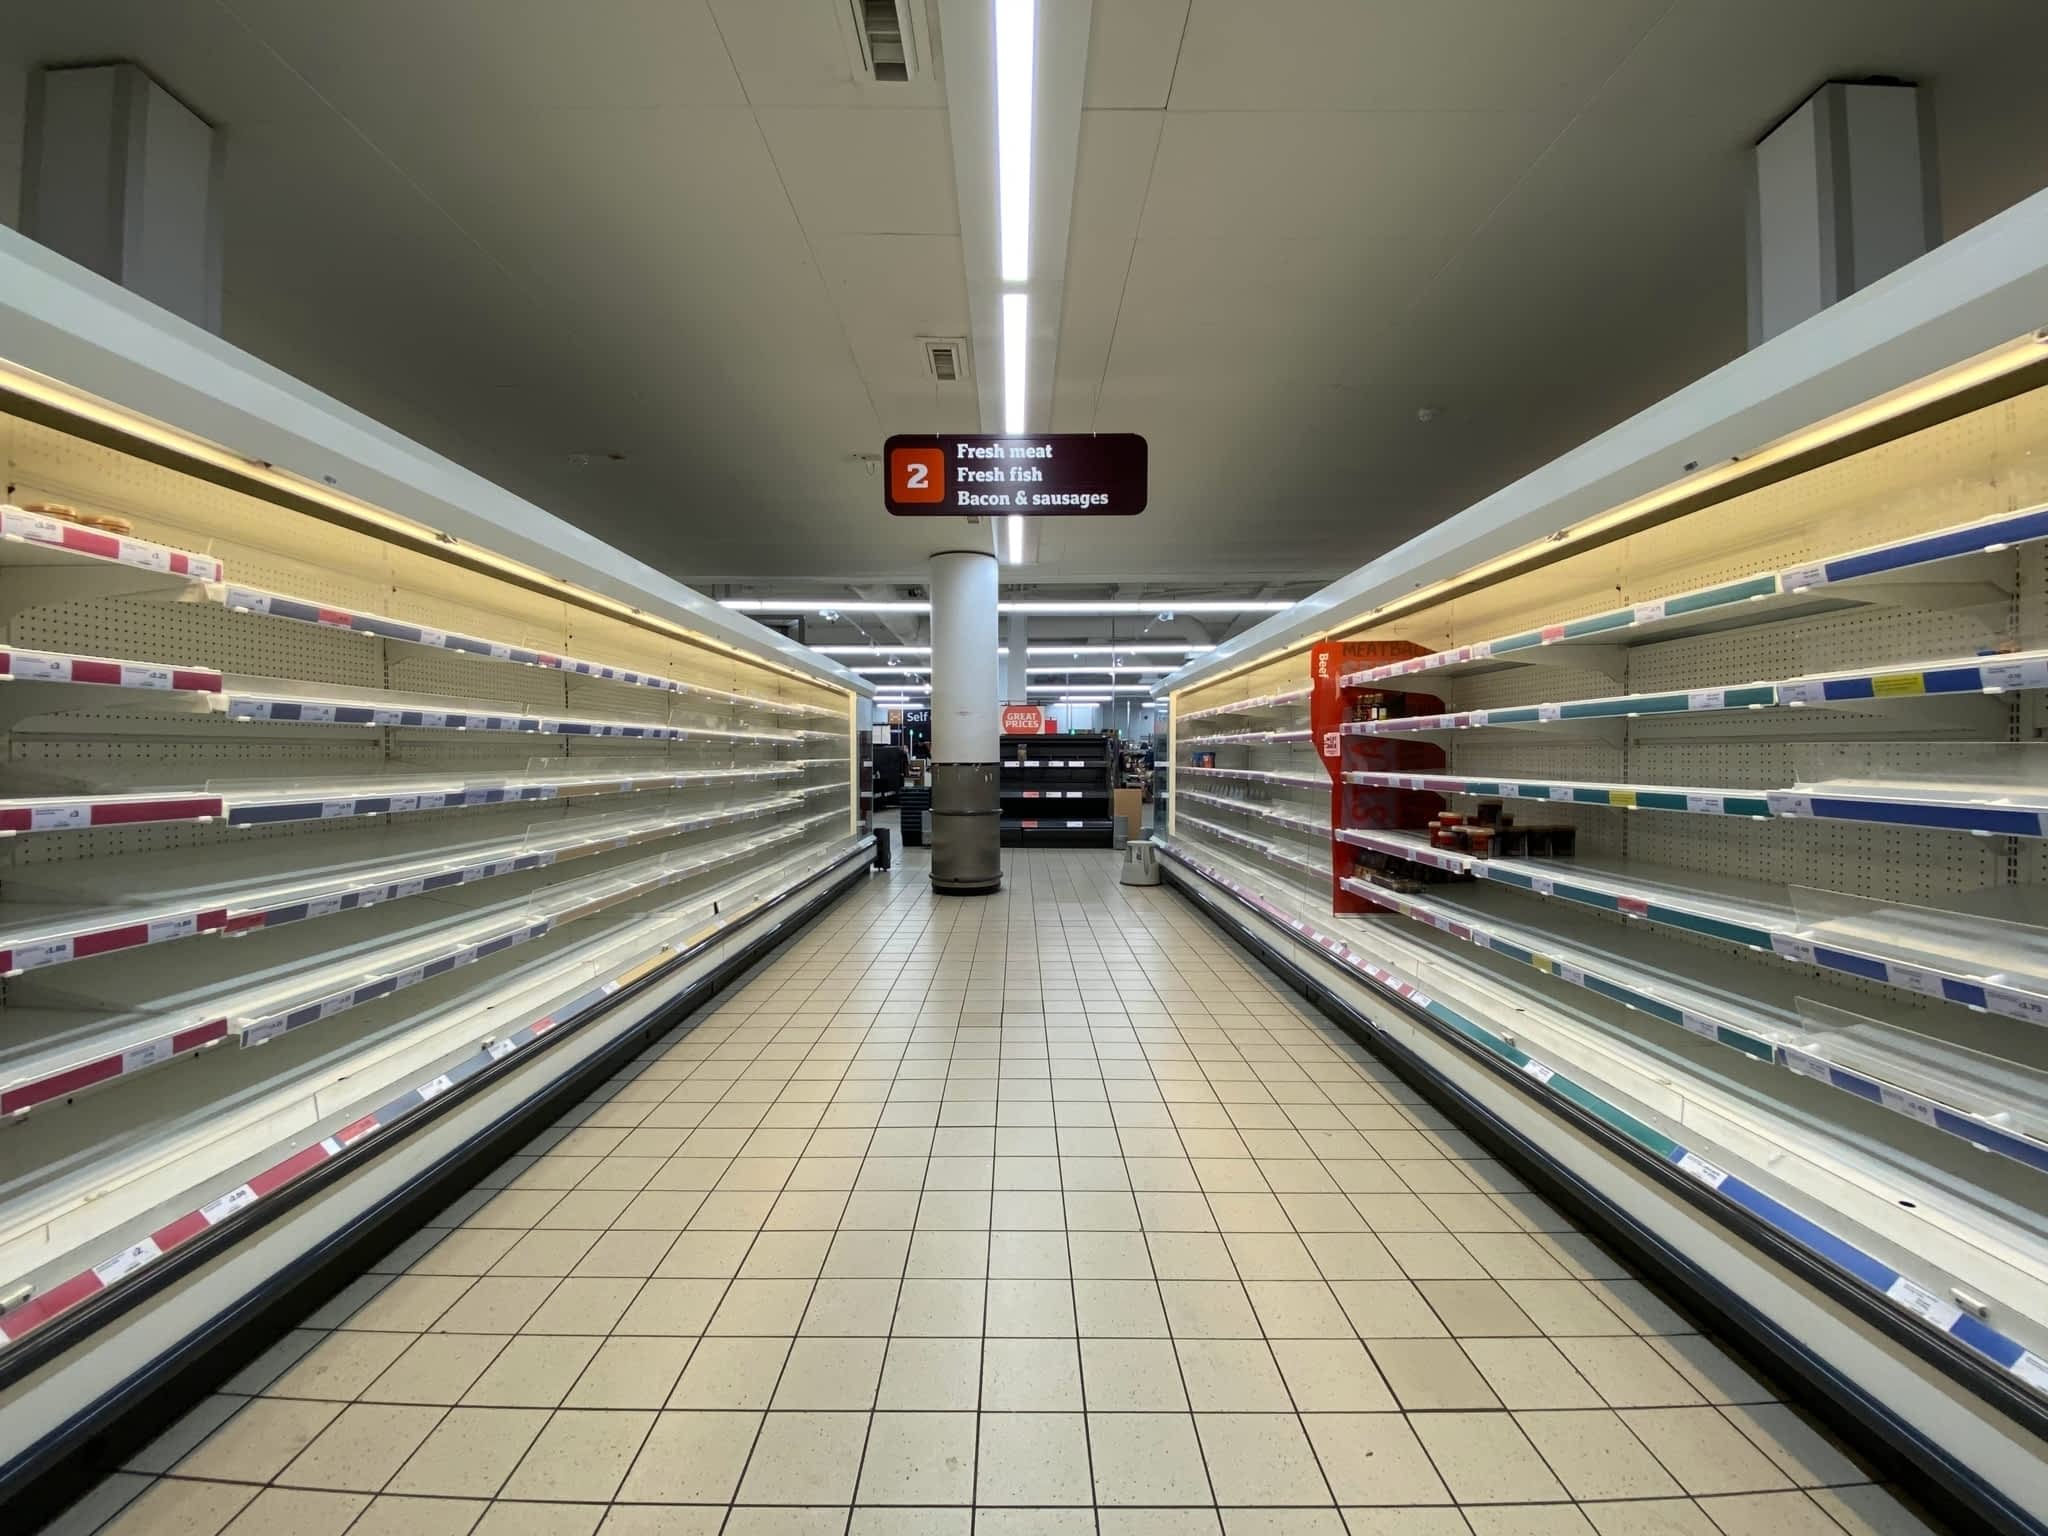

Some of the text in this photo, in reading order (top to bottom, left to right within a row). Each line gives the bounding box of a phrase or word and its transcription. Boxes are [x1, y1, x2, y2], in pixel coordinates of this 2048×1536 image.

[957, 443, 1053, 459] Fresh meat
[906, 463, 929, 489] 2
[957, 466, 1043, 482] Fresh fish
[957, 490, 1109, 509] Bacon & sausages
[1318, 652, 1329, 679] Beef
[906, 711, 929, 723] Self
[1005, 720, 1039, 729] PRICES
[1007, 712, 1037, 721] GREAT
